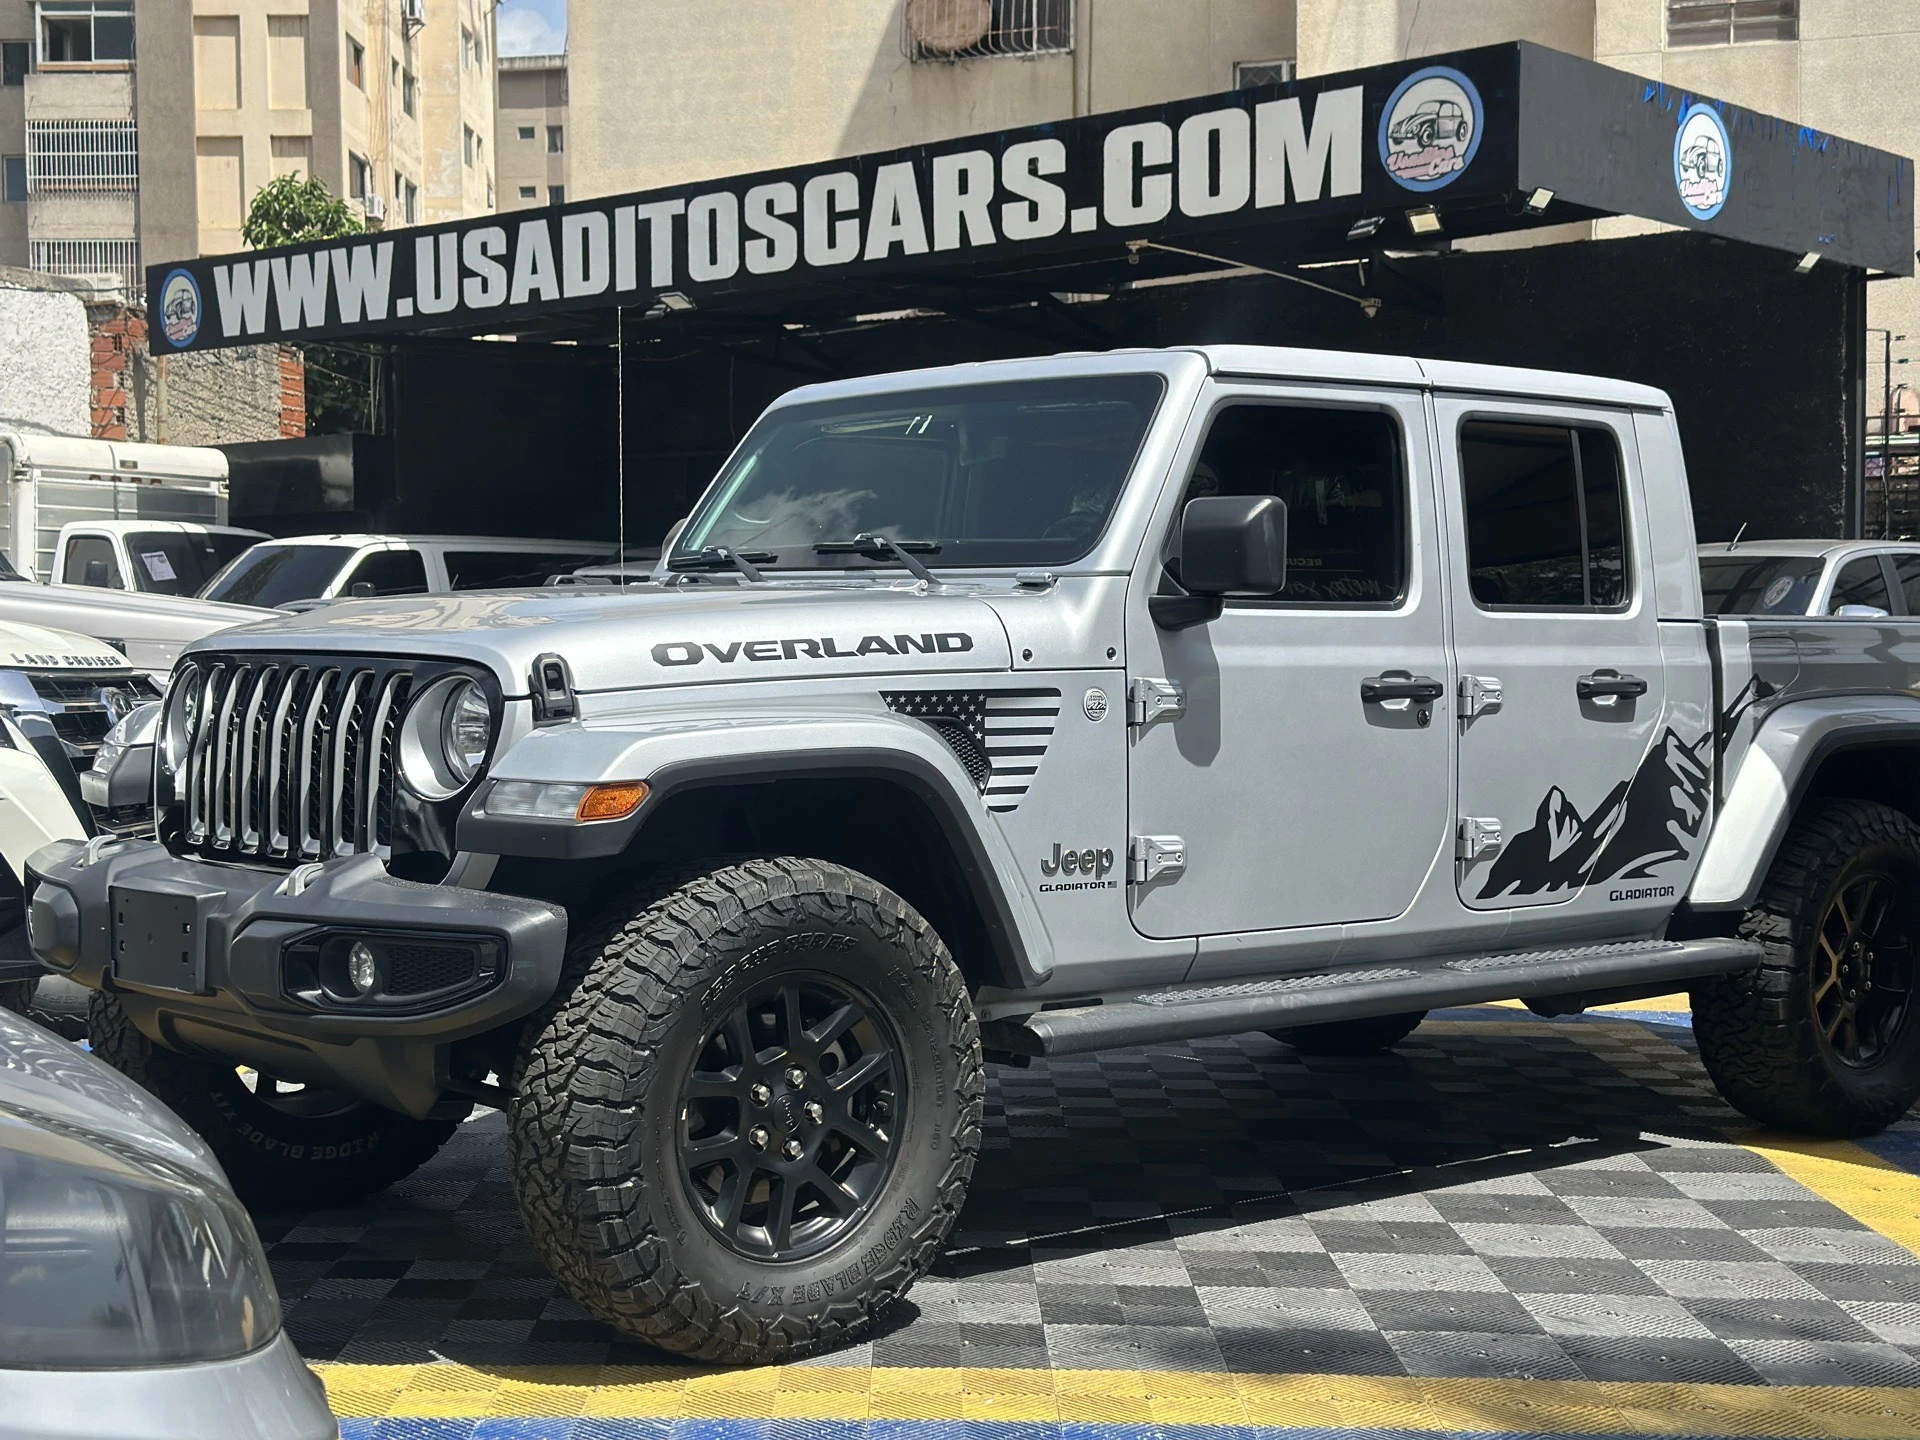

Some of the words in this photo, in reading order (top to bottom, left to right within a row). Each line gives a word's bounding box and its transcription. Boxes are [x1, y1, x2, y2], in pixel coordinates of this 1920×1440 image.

[213, 85, 1364, 337] WWW.USADITOSCARS.COM
[9, 653, 59, 665] LAND
[61, 655, 122, 666] CRUISER
[650, 632, 974, 667] OVERLAND
[1041, 842, 1114, 880] Jeep
[1039, 881, 1106, 893] GLADIATOR
[1609, 886, 1675, 902] GLADIATOR
[861, 1196, 921, 1275] RIDGE
[792, 1262, 862, 1305] BLADE
